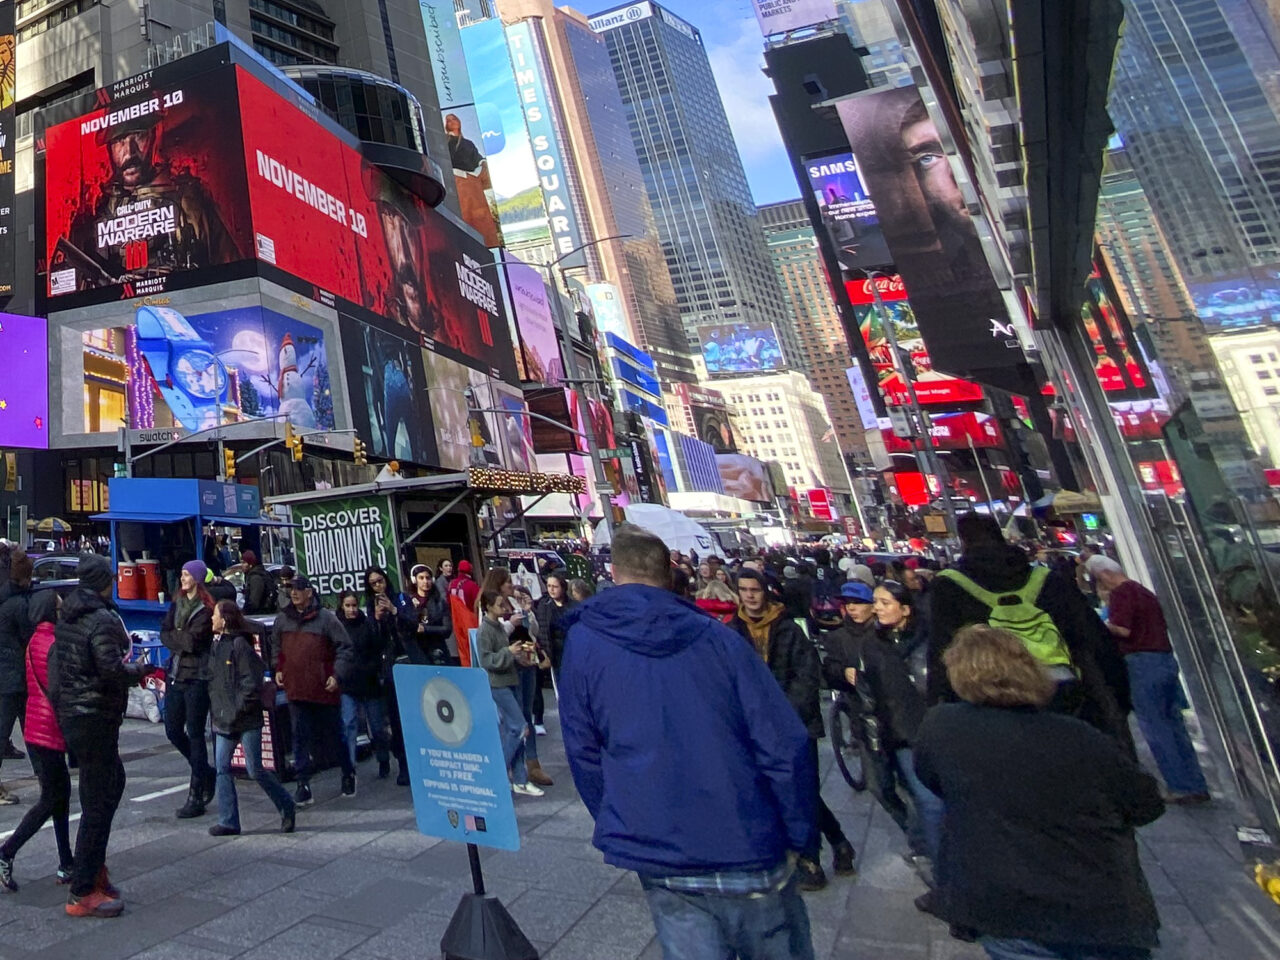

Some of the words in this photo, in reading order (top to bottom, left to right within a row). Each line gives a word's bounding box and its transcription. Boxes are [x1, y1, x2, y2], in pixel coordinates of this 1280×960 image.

[759, 0, 781, 11] PUBLIC
[761, 5, 792, 18] MARKETS
[588, 14, 625, 31] Allianz
[421, 1, 453, 103] unsubscribed
[113, 70, 154, 91] MARRIOTT
[113, 81, 150, 100] MARQUIS
[81, 96, 160, 136] NOVEMBER
[163, 90, 184, 109] 10
[510, 34, 542, 122] TIMES
[534, 136, 574, 254] SQUARE
[256, 149, 348, 227] NOVEMBER
[349, 209, 368, 239] 10
[97, 205, 175, 236] MODERN
[98, 219, 176, 248] WARFARE
[136, 277, 166, 288] MARRIOTT
[136, 284, 164, 295] MARQUIS
[455, 261, 496, 300] MODERN
[459, 280, 499, 317] WARFARE
[139, 431, 173, 442] swatch
[301, 506, 381, 532] DISCOVER
[303, 522, 387, 576] BROADWAY'S
[309, 572, 366, 595] SECRE
[420, 747, 426, 756] IF
[427, 749, 452, 759] YOU'RE
[453, 752, 483, 762] HANDED
[483, 756, 490, 764] A
[429, 758, 461, 770] COMPACT
[439, 769, 452, 779] IT'S
[422, 778, 450, 791] TIPPING
[452, 784, 458, 792] IS
